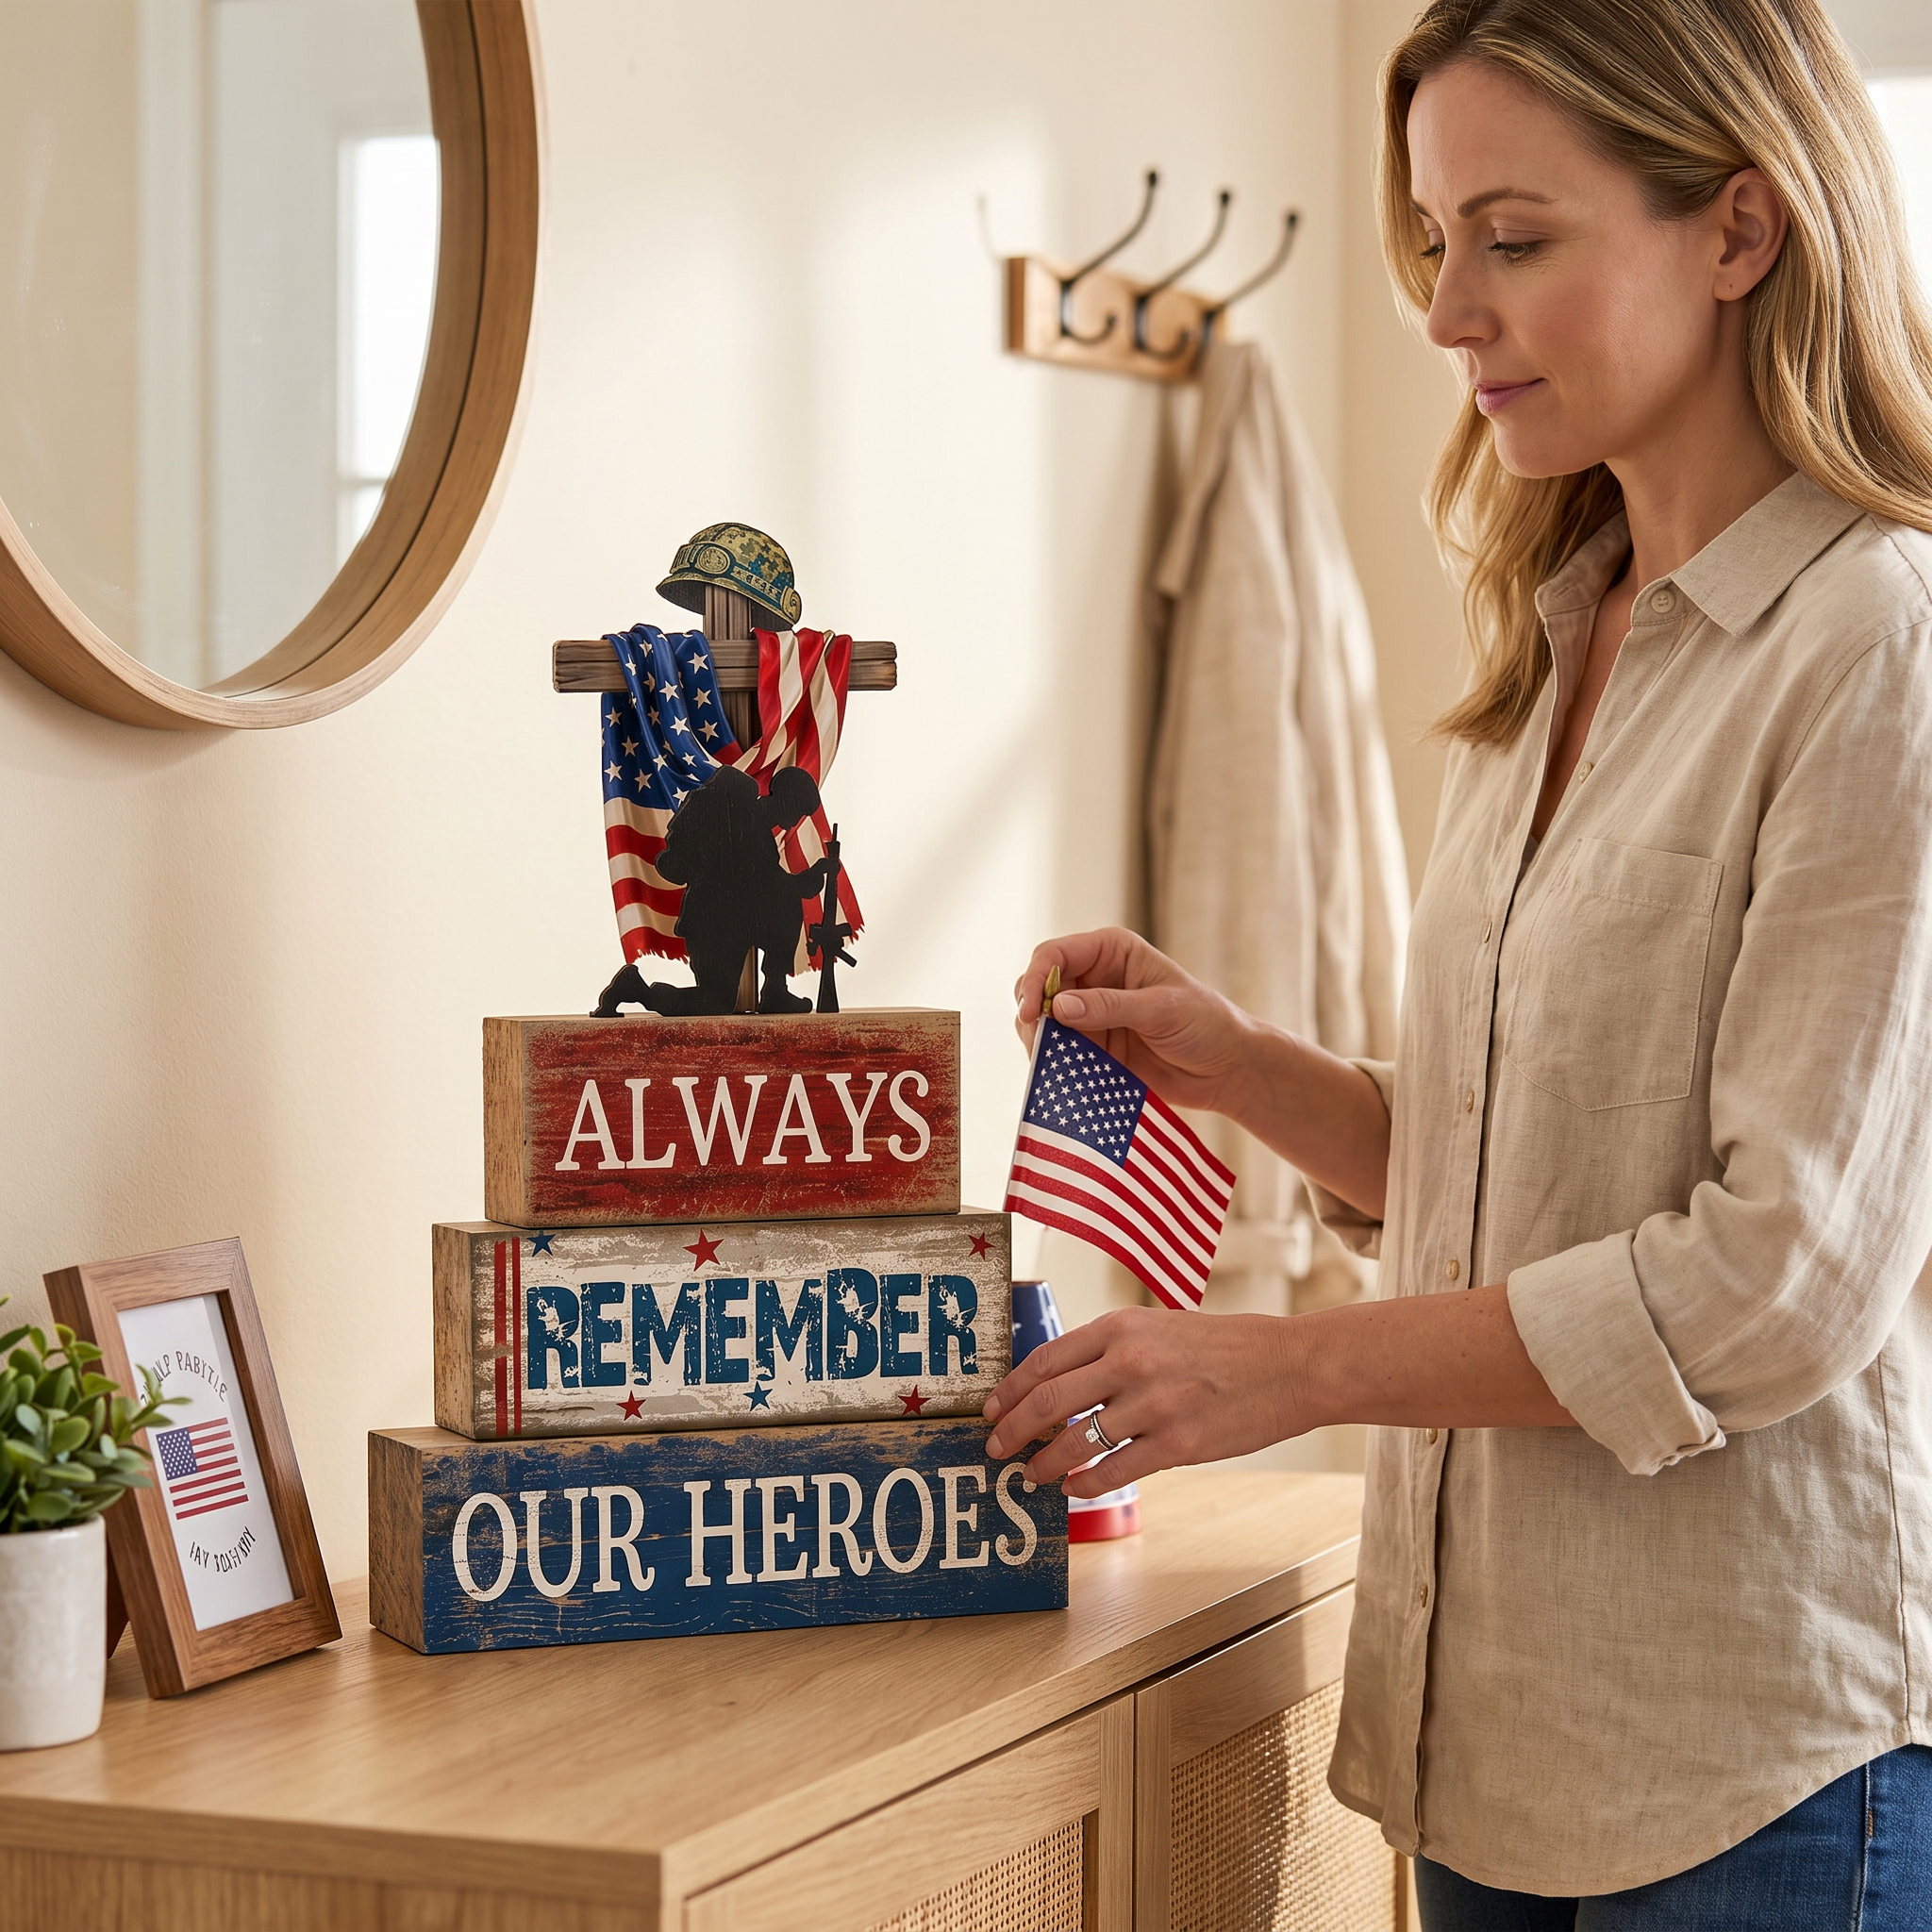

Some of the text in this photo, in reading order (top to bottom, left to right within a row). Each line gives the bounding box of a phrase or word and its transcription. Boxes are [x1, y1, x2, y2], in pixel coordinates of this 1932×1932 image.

[555, 1071, 931, 1171] ALWAYS
[527, 1268, 978, 1390] REMEMBER
[453, 1462, 1038, 1603] OUR HEROES
